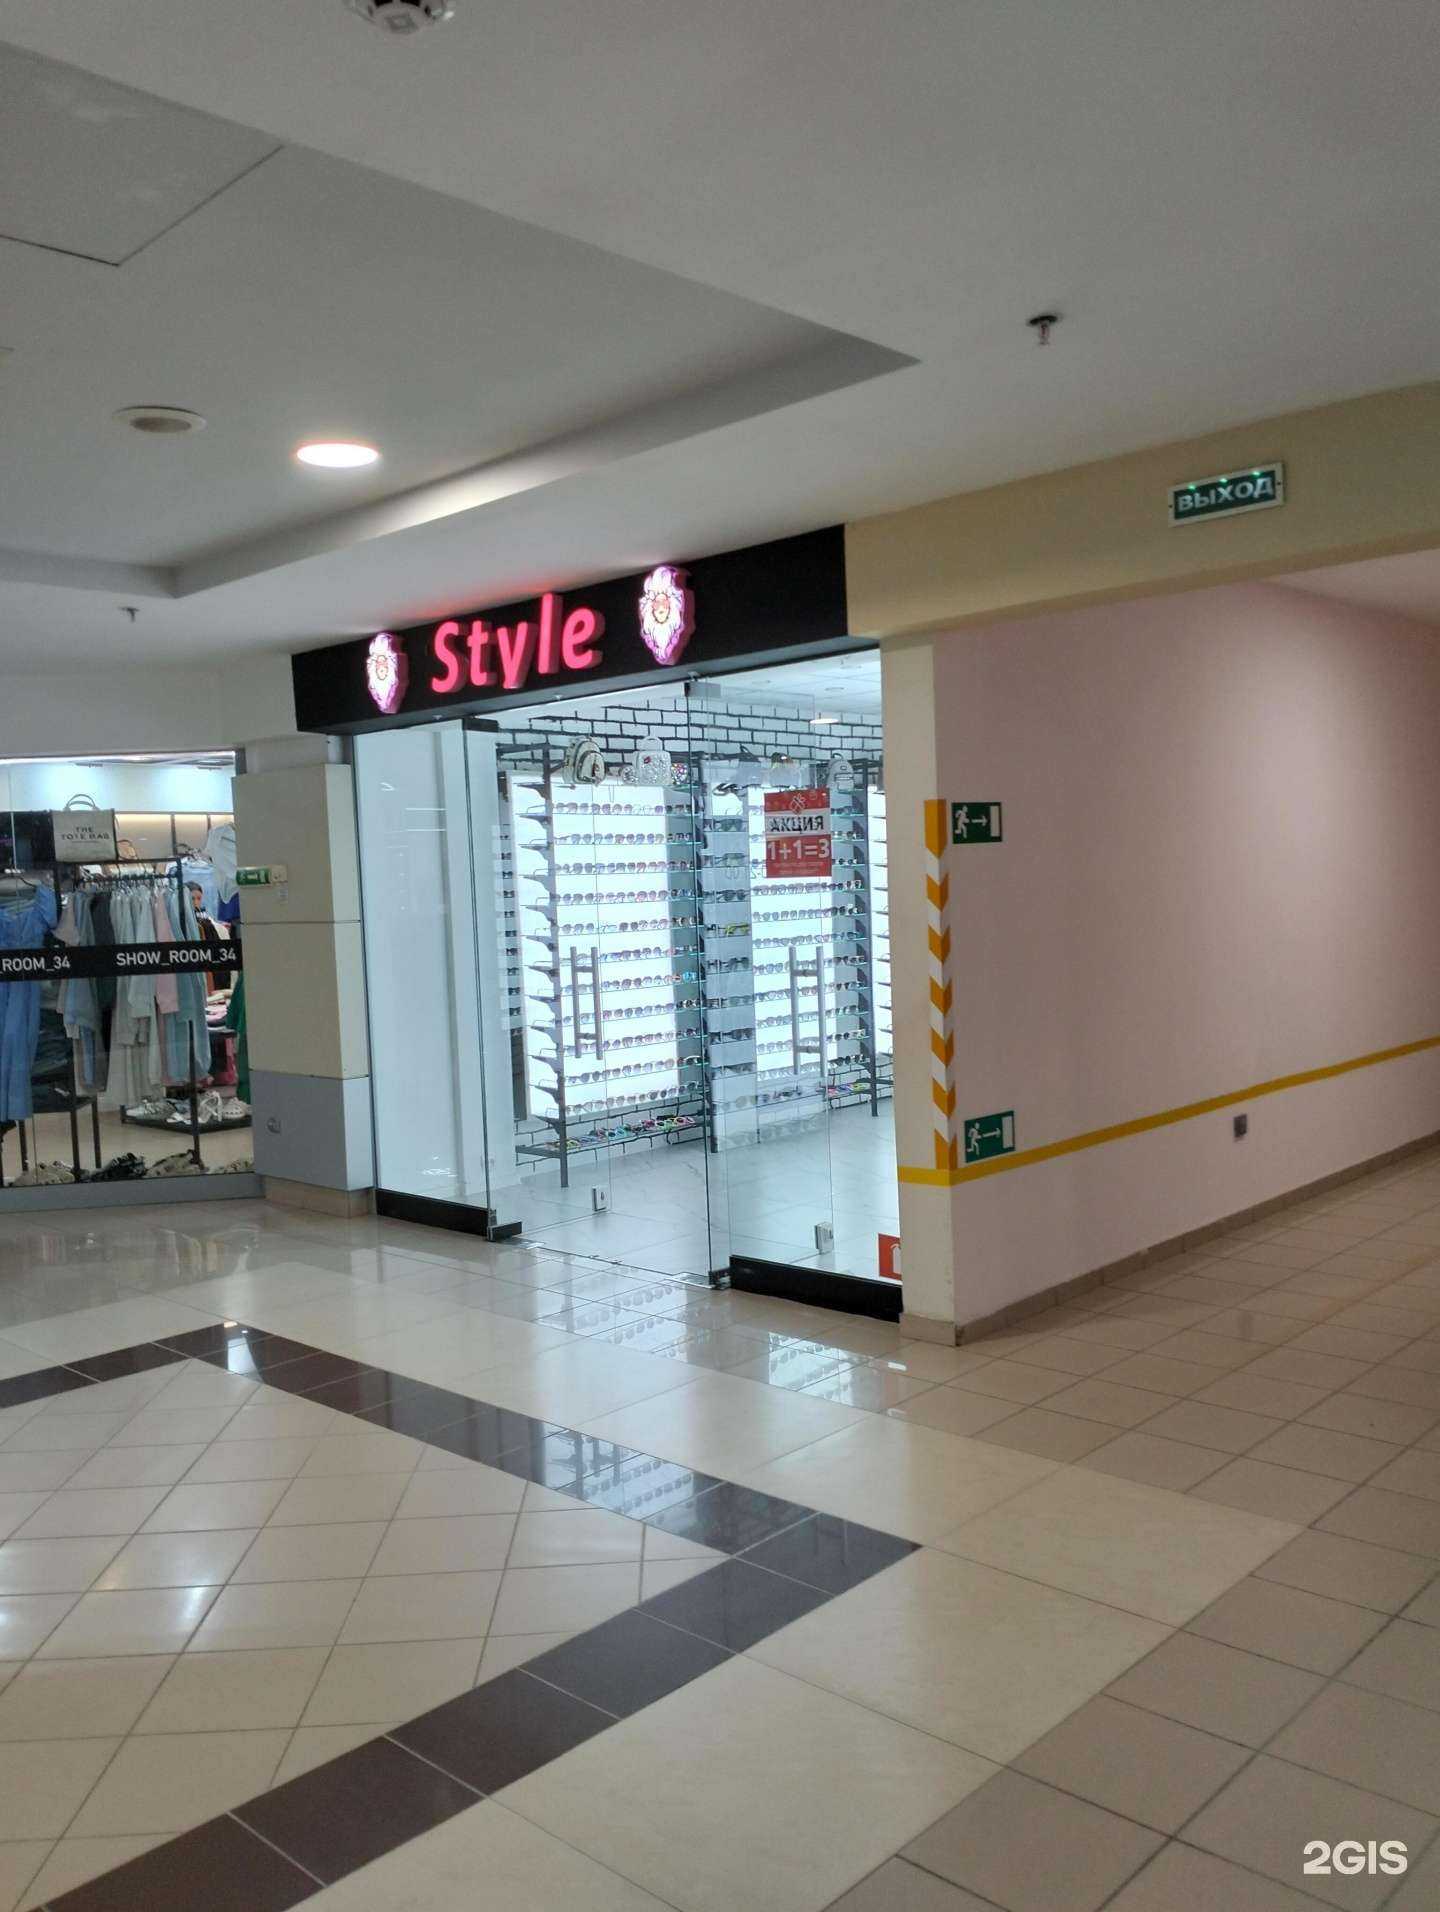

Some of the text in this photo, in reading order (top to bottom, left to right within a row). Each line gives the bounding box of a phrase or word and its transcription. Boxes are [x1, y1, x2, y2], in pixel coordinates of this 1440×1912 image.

[1177, 477, 1274, 512] ВЫХОД
[431, 592, 603, 693] Style
[769, 815, 825, 834] АКЦИЯ
[89, 832, 110, 840] BAG
[767, 838, 830, 860] 1+1=3
[116, 947, 237, 966] SHOW_ROOM_34
